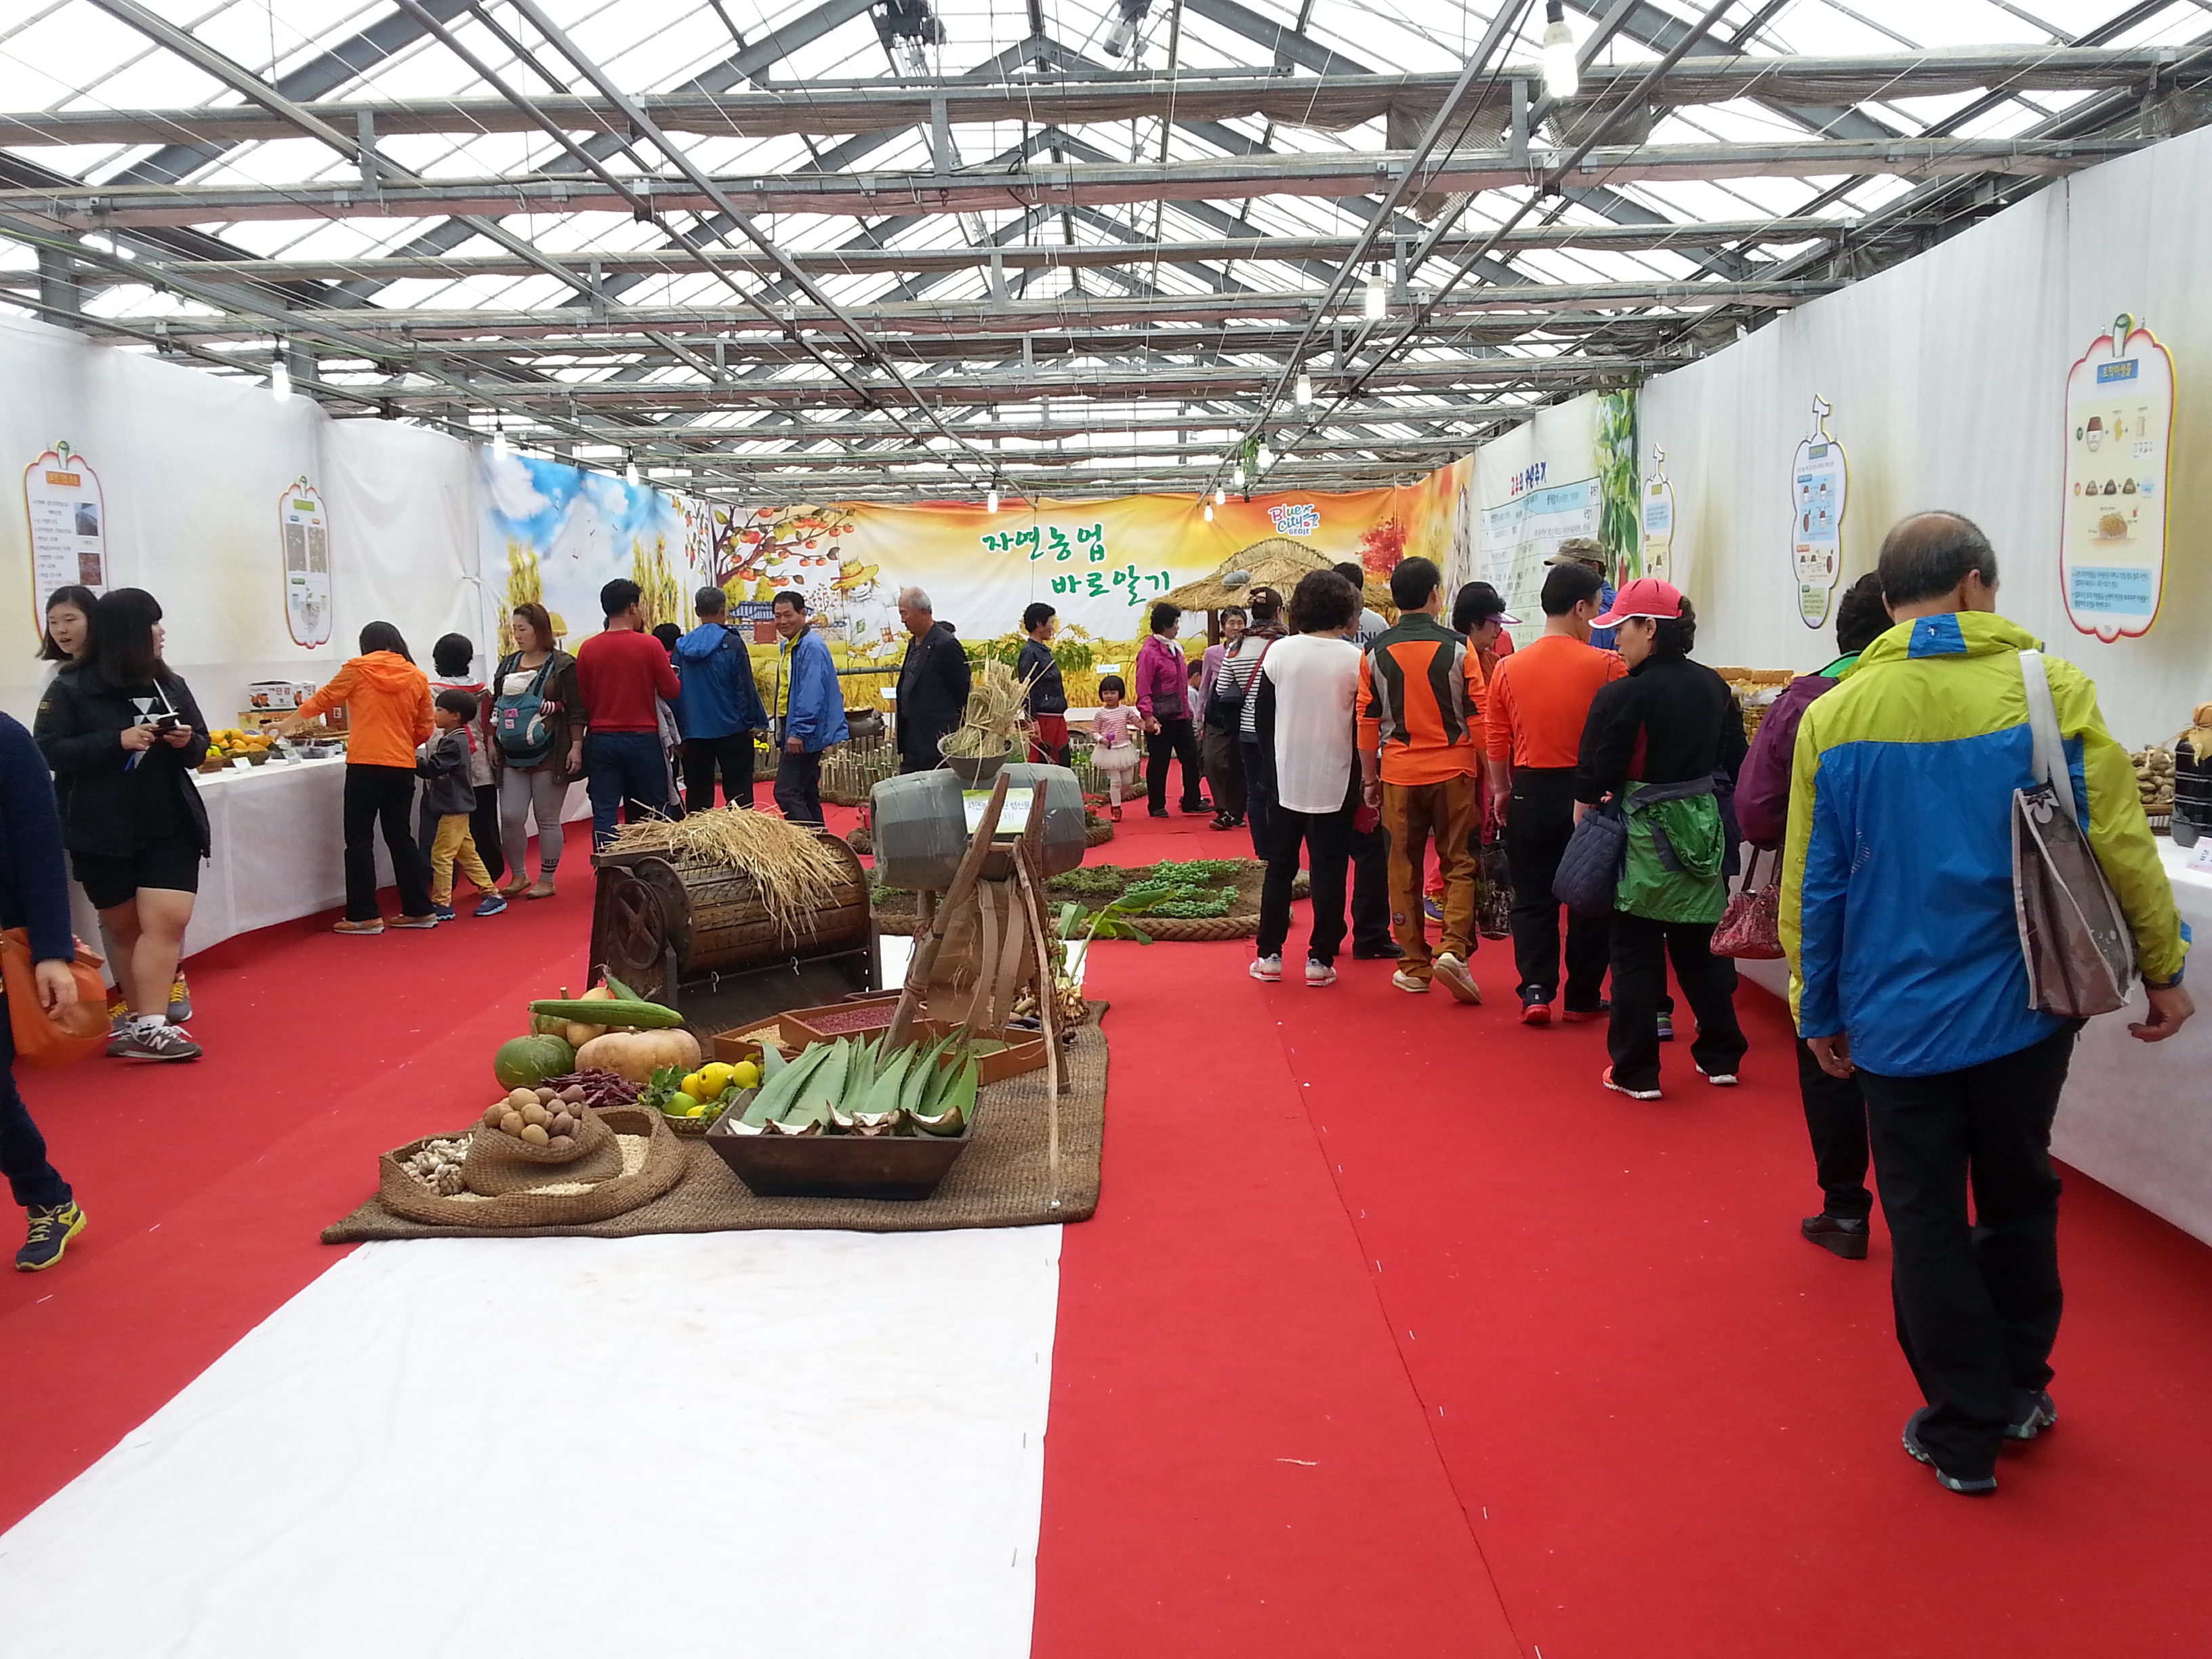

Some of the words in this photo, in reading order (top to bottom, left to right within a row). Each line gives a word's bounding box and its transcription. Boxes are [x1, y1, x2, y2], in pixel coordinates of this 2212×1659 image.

[1269, 505, 1301, 522] Blue
[1277, 516, 1302, 532] City
[983, 524, 1105, 562] 자연농업
[1051, 565, 1170, 607] 바로알기
[149, 1036, 169, 1050] N
